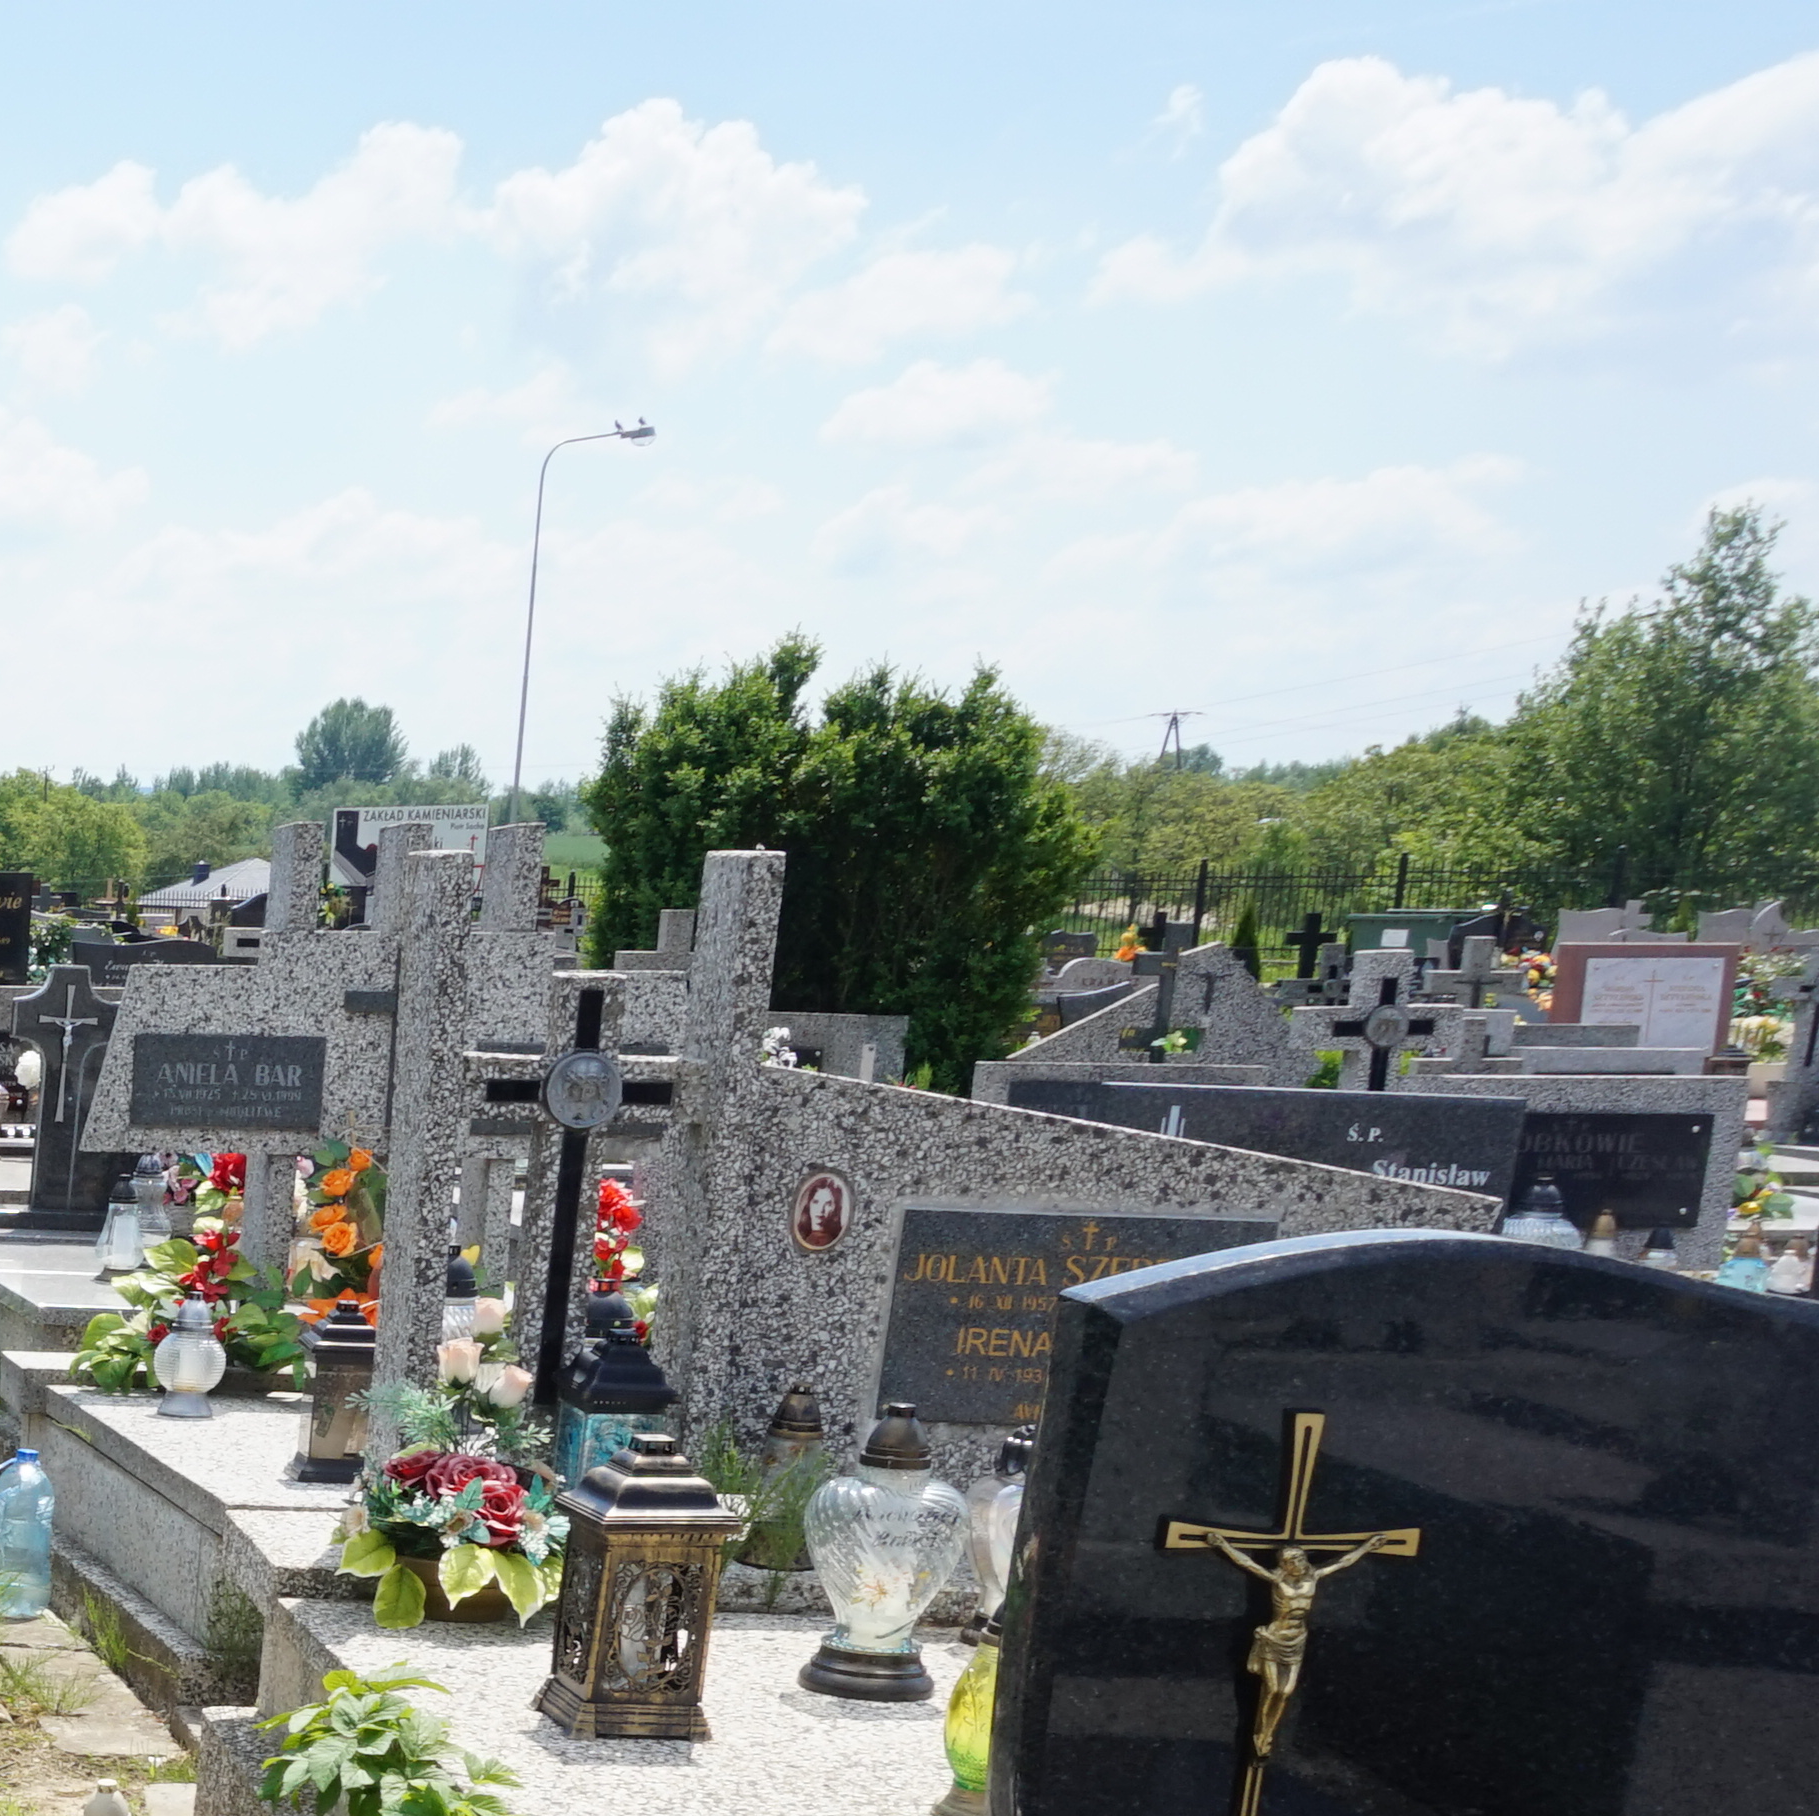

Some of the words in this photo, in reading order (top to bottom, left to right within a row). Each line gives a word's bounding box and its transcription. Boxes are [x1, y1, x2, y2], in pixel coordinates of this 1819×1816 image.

[364, 810, 404, 822] ZAKŁAD
[408, 808, 486, 821] KAMIENIARSKI
[156, 1062, 239, 1086] ANIELA
[255, 1064, 302, 1087] BAR
[1372, 1159, 1491, 1188] Stanisław
[904, 1253, 1047, 1286] JOLANTA
[968, 1294, 984, 1309] 16
[1022, 1296, 1058, 1312] 1957
[957, 1328, 1052, 1357] IRENA
[963, 1367, 976, 1379] 11
[1016, 1368, 1044, 1384] 193
